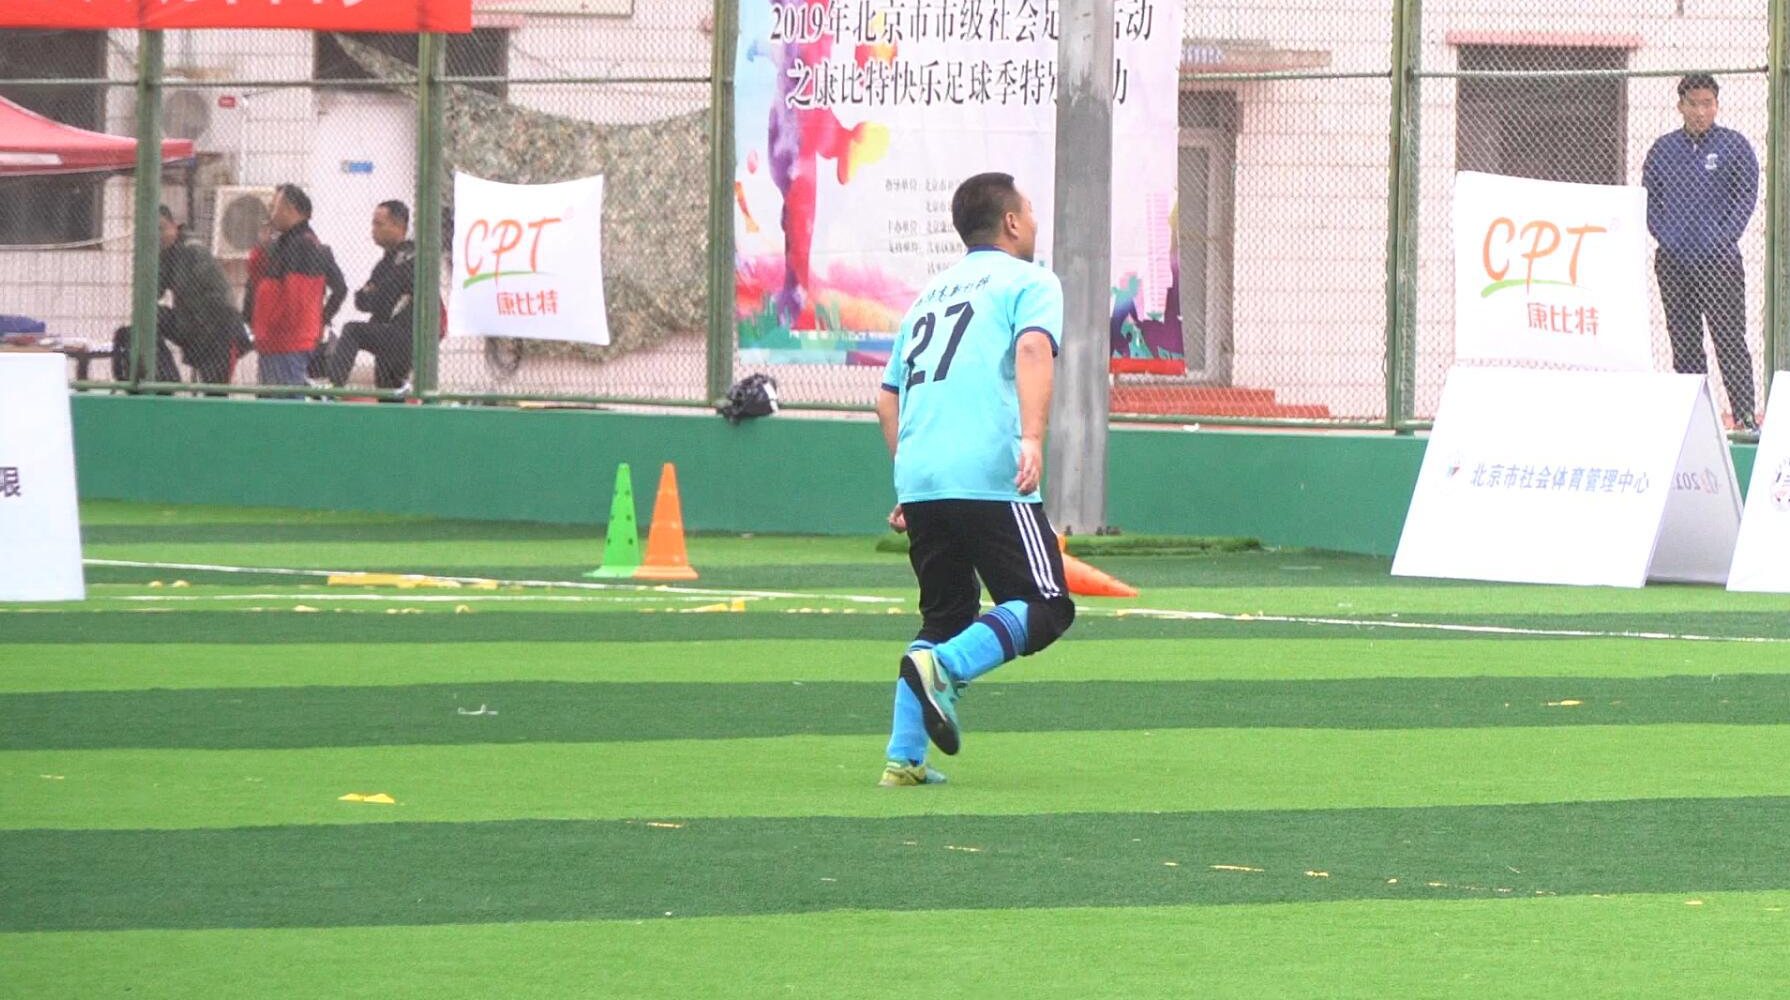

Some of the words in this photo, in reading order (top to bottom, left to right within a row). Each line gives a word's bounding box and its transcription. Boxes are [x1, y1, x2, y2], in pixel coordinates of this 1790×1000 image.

[464, 217, 562, 286] CPT
[1482, 216, 1608, 295] CPT
[496, 290, 558, 316] 康比特
[1526, 302, 1600, 336] 康比特
[906, 300, 975, 391] 27
[1470, 462, 1651, 494] 北京市社会体育管理中心
